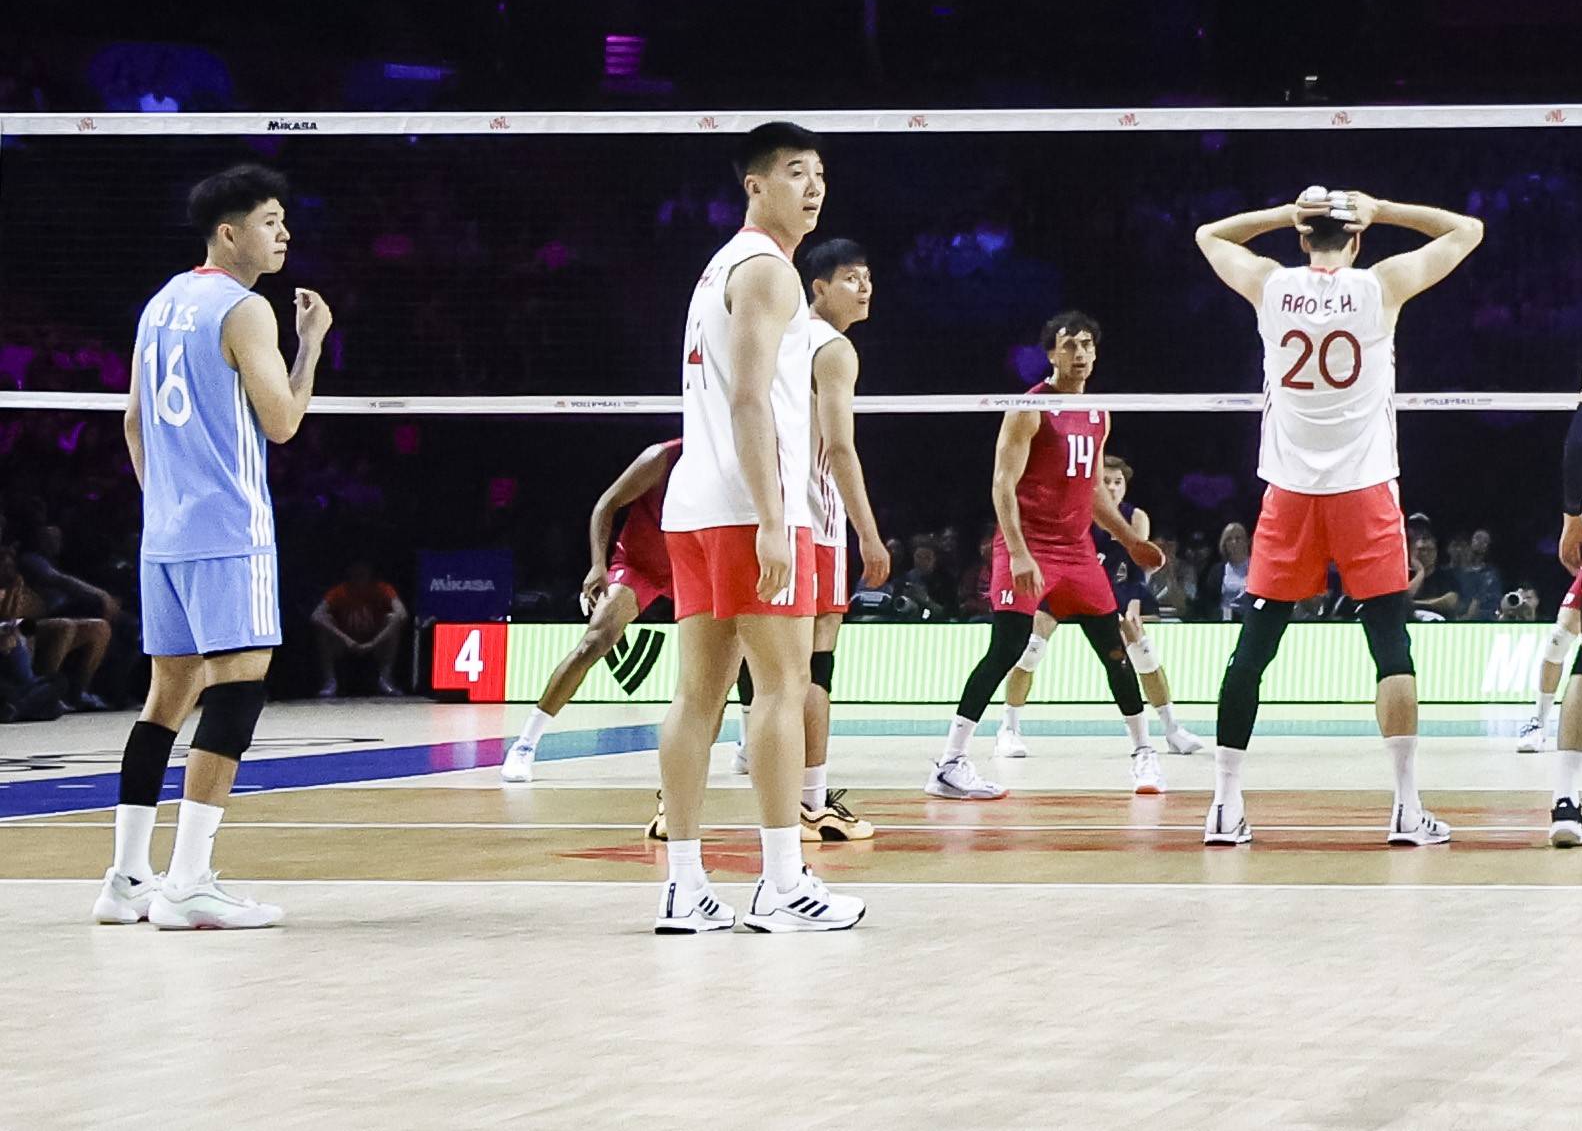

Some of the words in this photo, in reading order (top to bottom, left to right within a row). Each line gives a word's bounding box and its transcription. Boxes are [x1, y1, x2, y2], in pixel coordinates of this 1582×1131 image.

[1281, 293, 1317, 314] RAO
[1324, 294, 1357, 316] S.H.
[1280, 329, 1362, 389] 20
[144, 341, 193, 427] 16
[1066, 434, 1095, 479] 14
[1000, 589, 1014, 605] 14
[453, 629, 484, 682] 4
